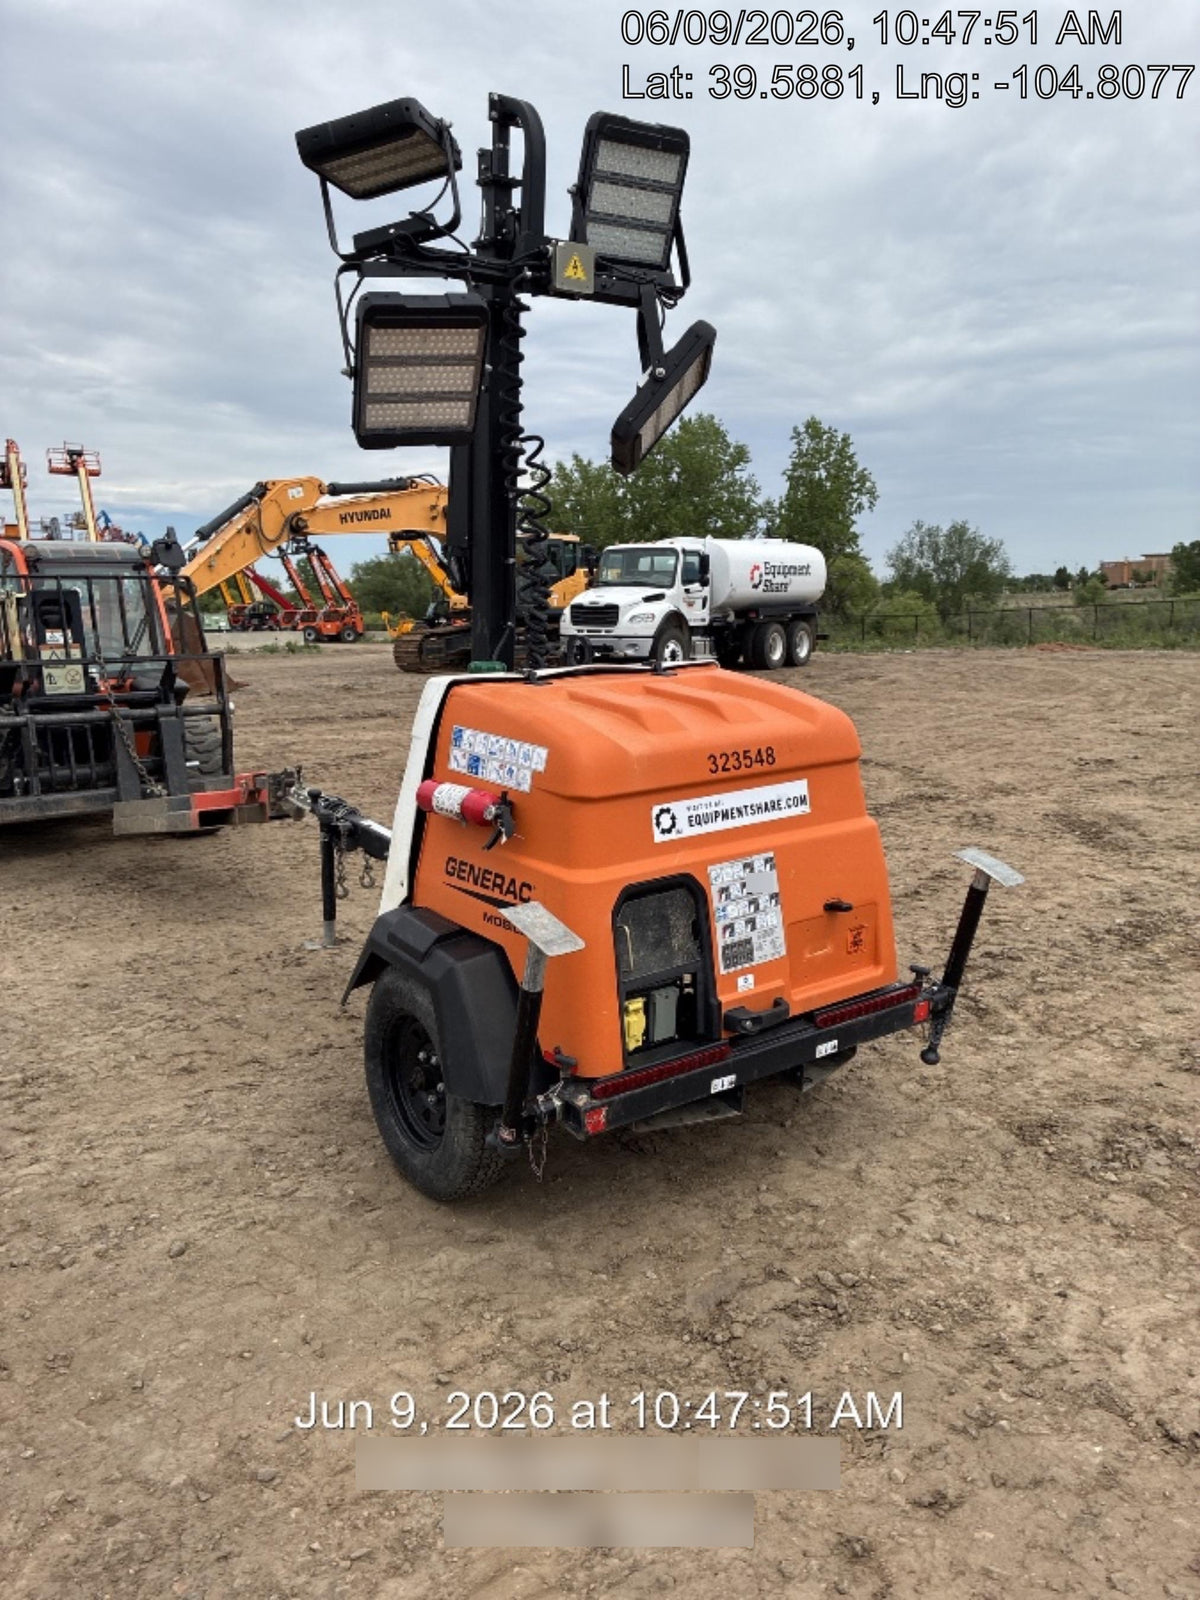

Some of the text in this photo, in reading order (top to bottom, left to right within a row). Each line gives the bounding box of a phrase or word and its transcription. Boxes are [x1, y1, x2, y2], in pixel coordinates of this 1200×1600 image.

[339, 508, 391, 525] HYUNDAI
[764, 561, 811, 578] Equipment
[707, 746, 776, 774] 323548
[687, 794, 808, 828] EQUIPMENTSHARE.COM
[445, 856, 533, 903] GENERAC
